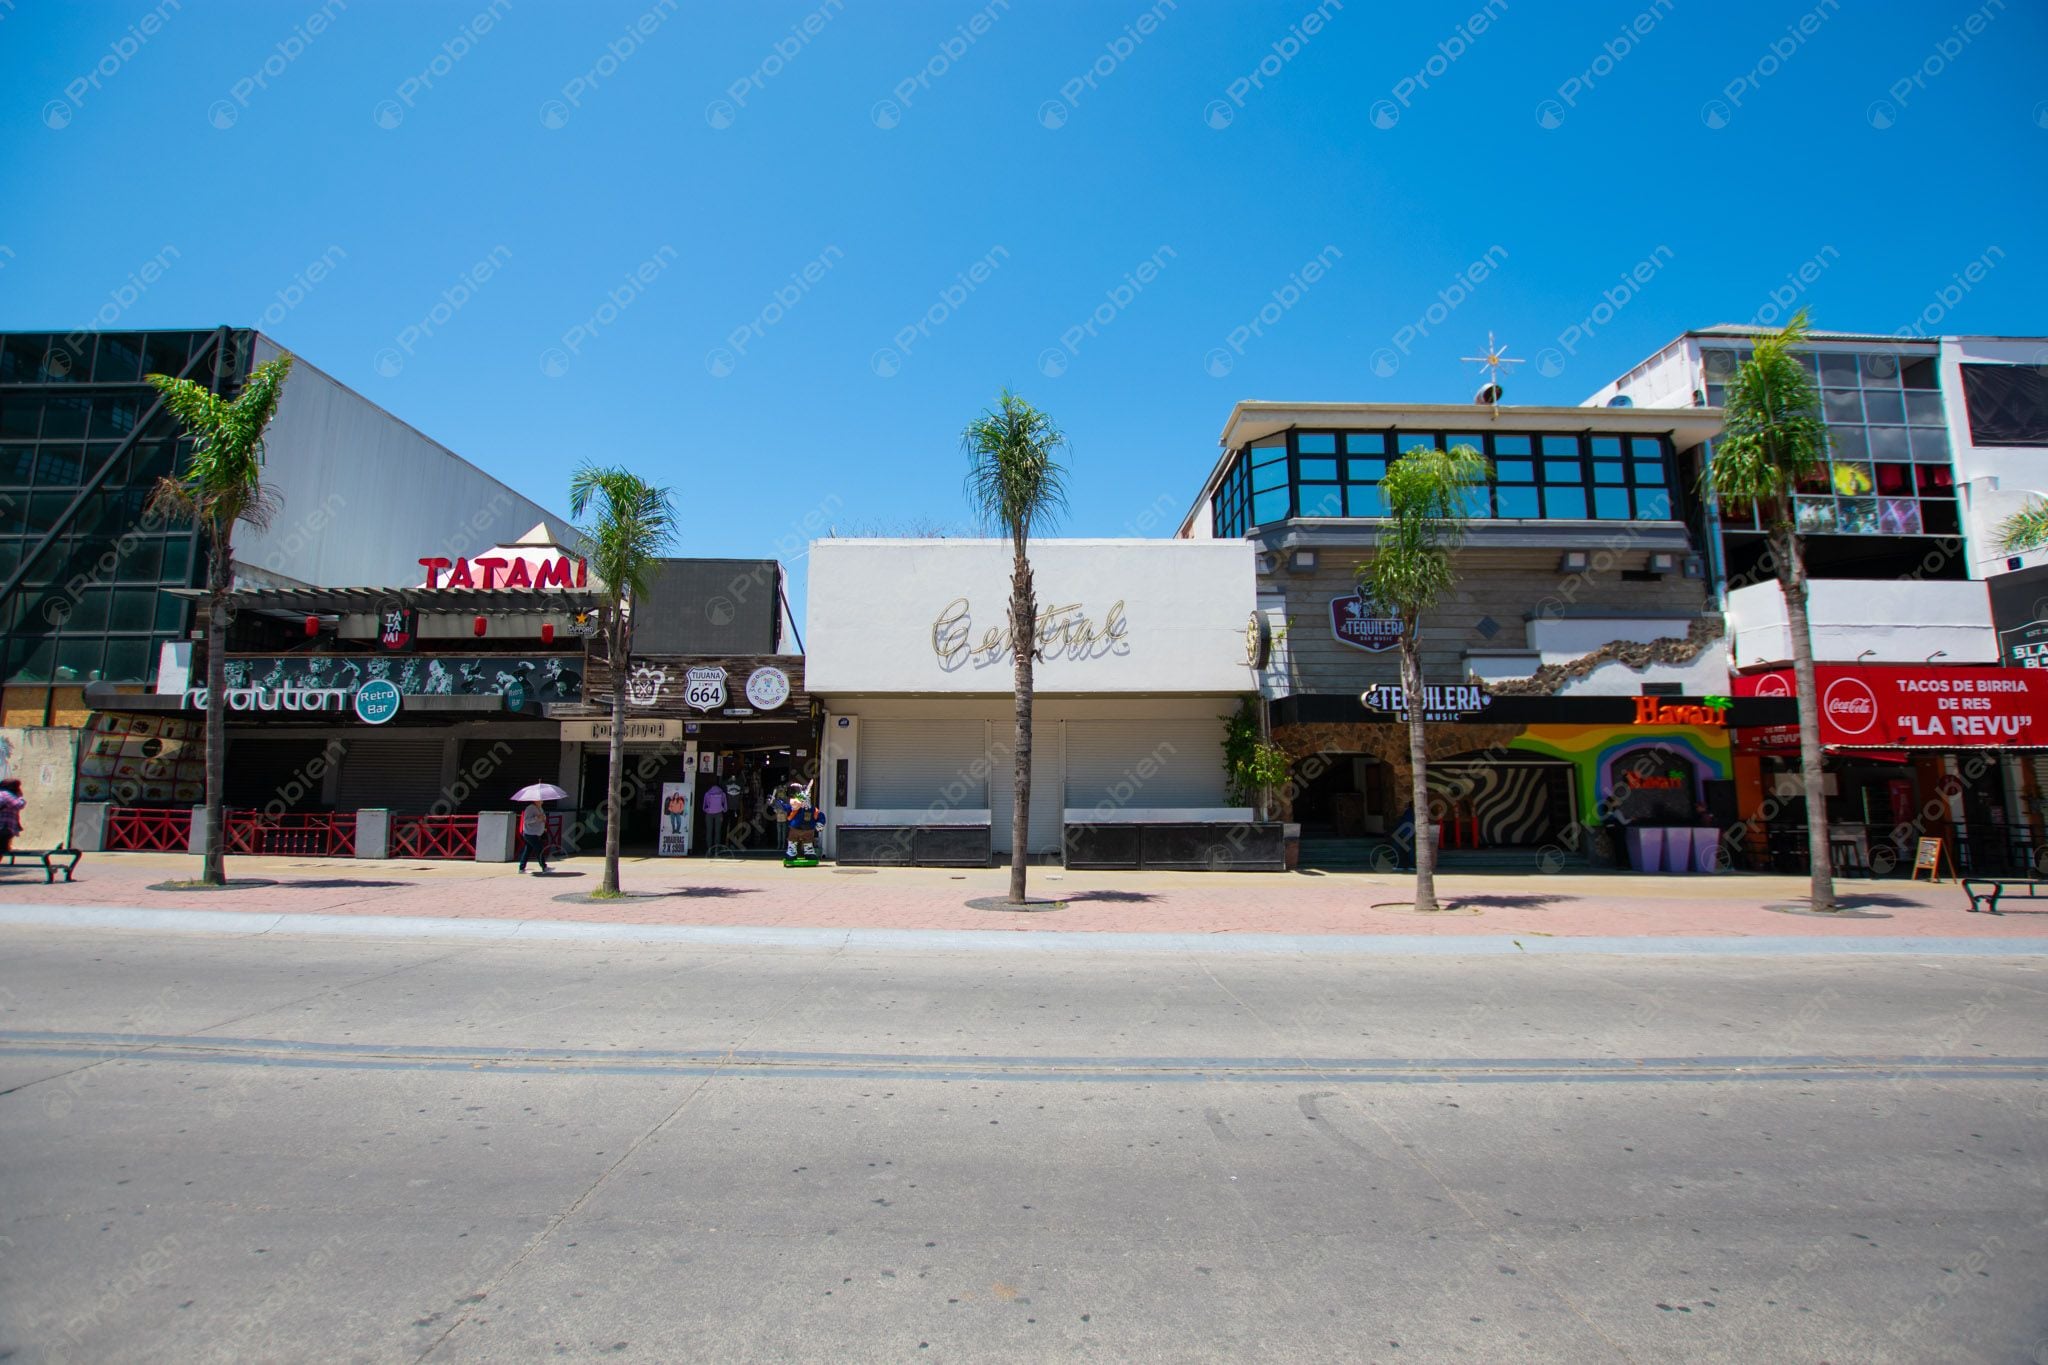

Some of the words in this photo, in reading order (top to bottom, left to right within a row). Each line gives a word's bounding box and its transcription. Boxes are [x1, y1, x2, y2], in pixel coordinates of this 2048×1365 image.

[418, 556, 587, 589] TATAMI
[386, 610, 402, 623] TA
[385, 620, 401, 632] TA
[383, 631, 398, 643] MI
[1897, 679, 1950, 692] TACOS
[1952, 680, 1973, 692] DE
[1976, 680, 2028, 693] BIRRIA
[360, 690, 395, 702] Retro
[690, 687, 720, 703] 664
[367, 703, 388, 715] Bar
[1937, 698, 1959, 710] DE
[1961, 698, 1992, 710] RES
